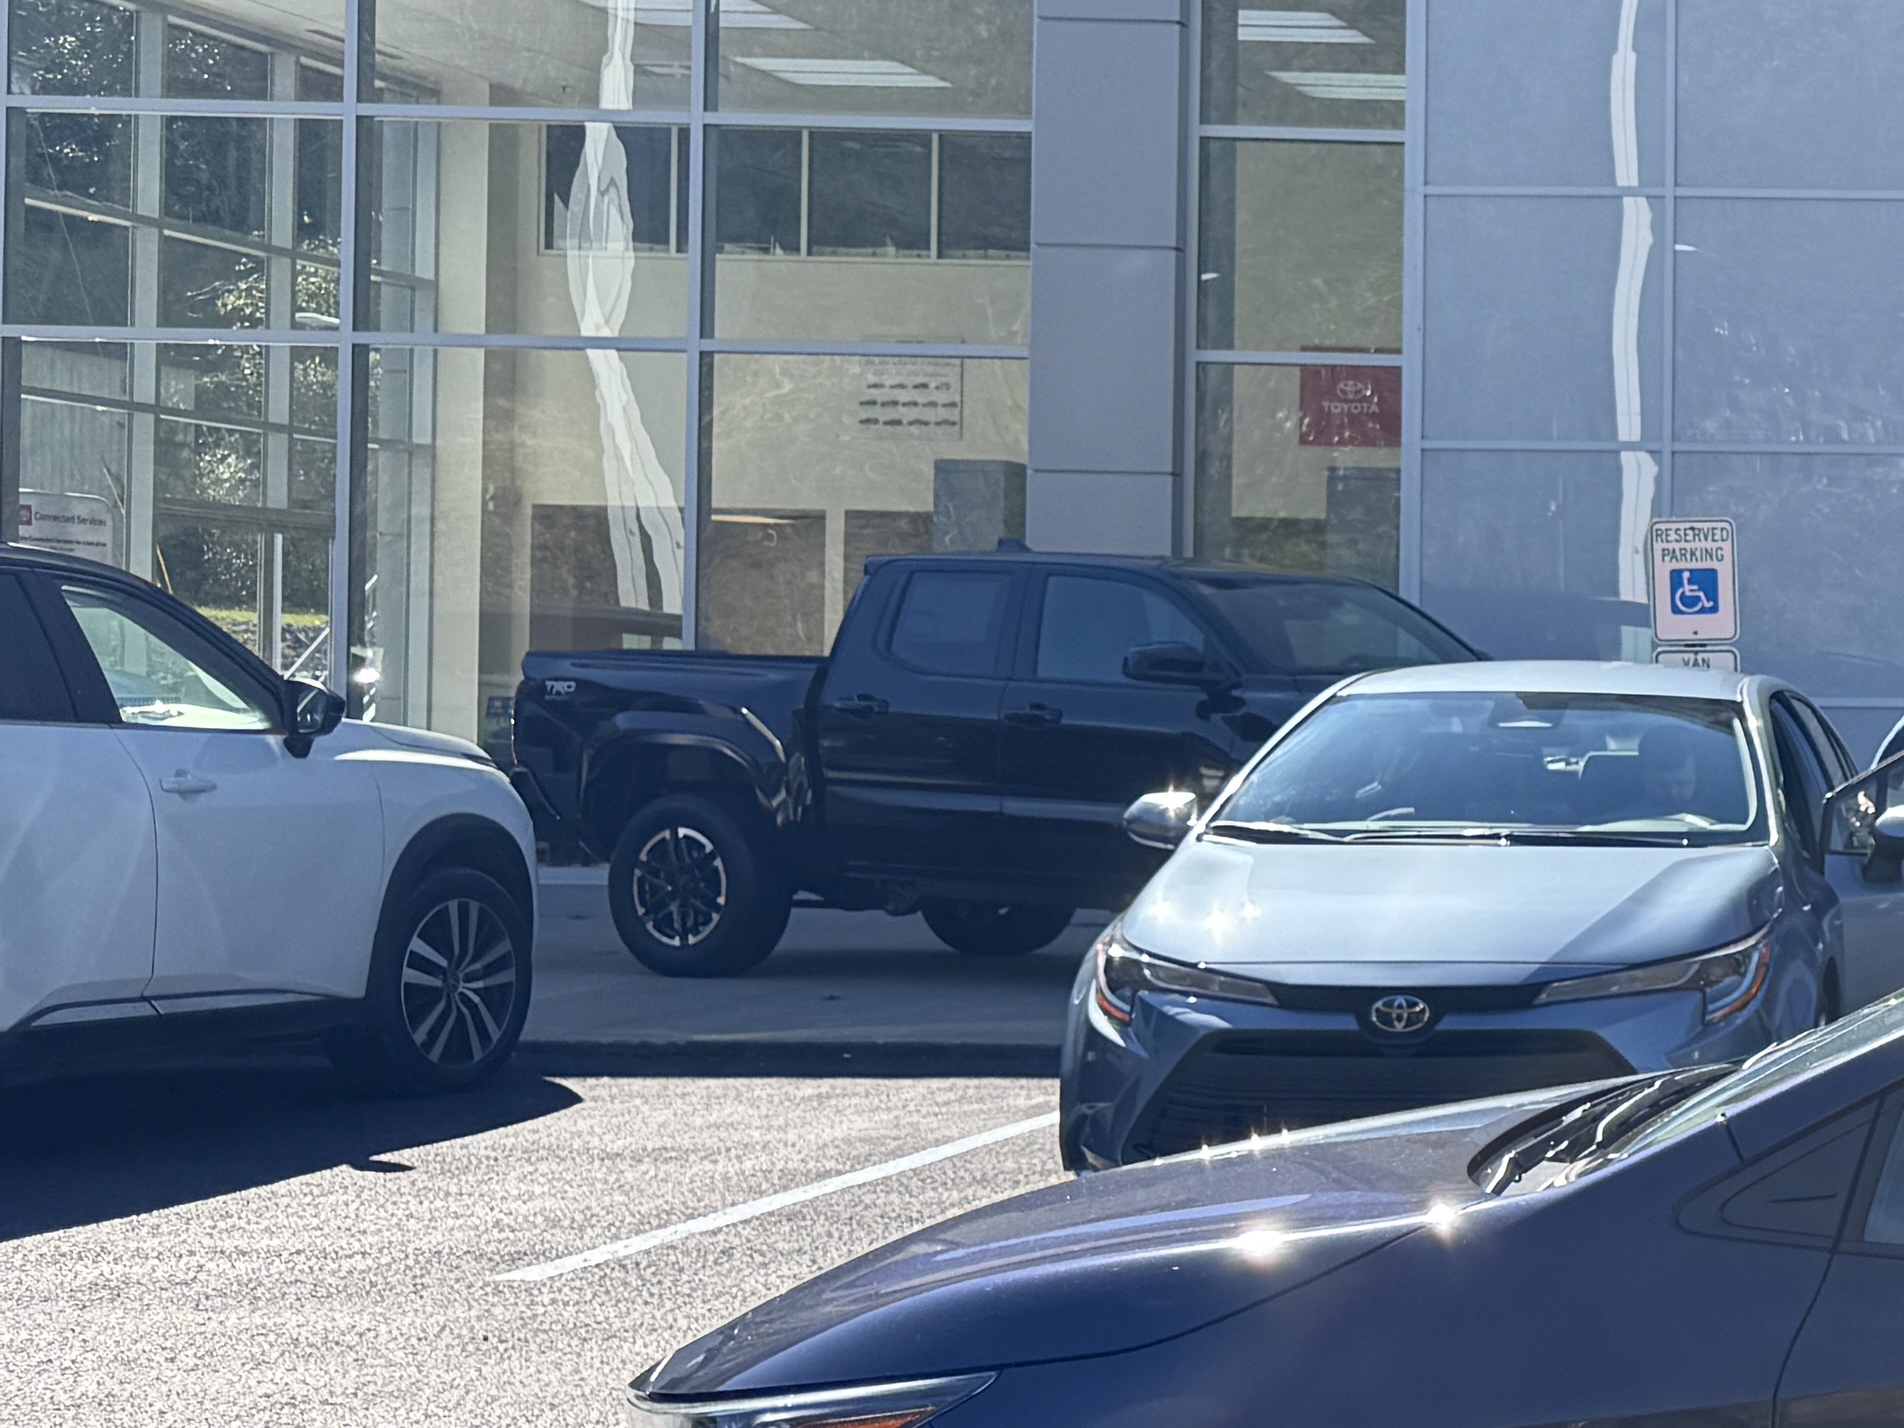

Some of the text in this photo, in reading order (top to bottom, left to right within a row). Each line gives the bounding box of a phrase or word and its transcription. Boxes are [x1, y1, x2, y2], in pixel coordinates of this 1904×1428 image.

[1322, 401, 1379, 413] TOYOTA
[34, 511, 107, 527] Connected Services
[1655, 527, 1730, 544] RESERVED
[1661, 547, 1725, 563] PARKING
[1682, 656, 1711, 670] VAN
